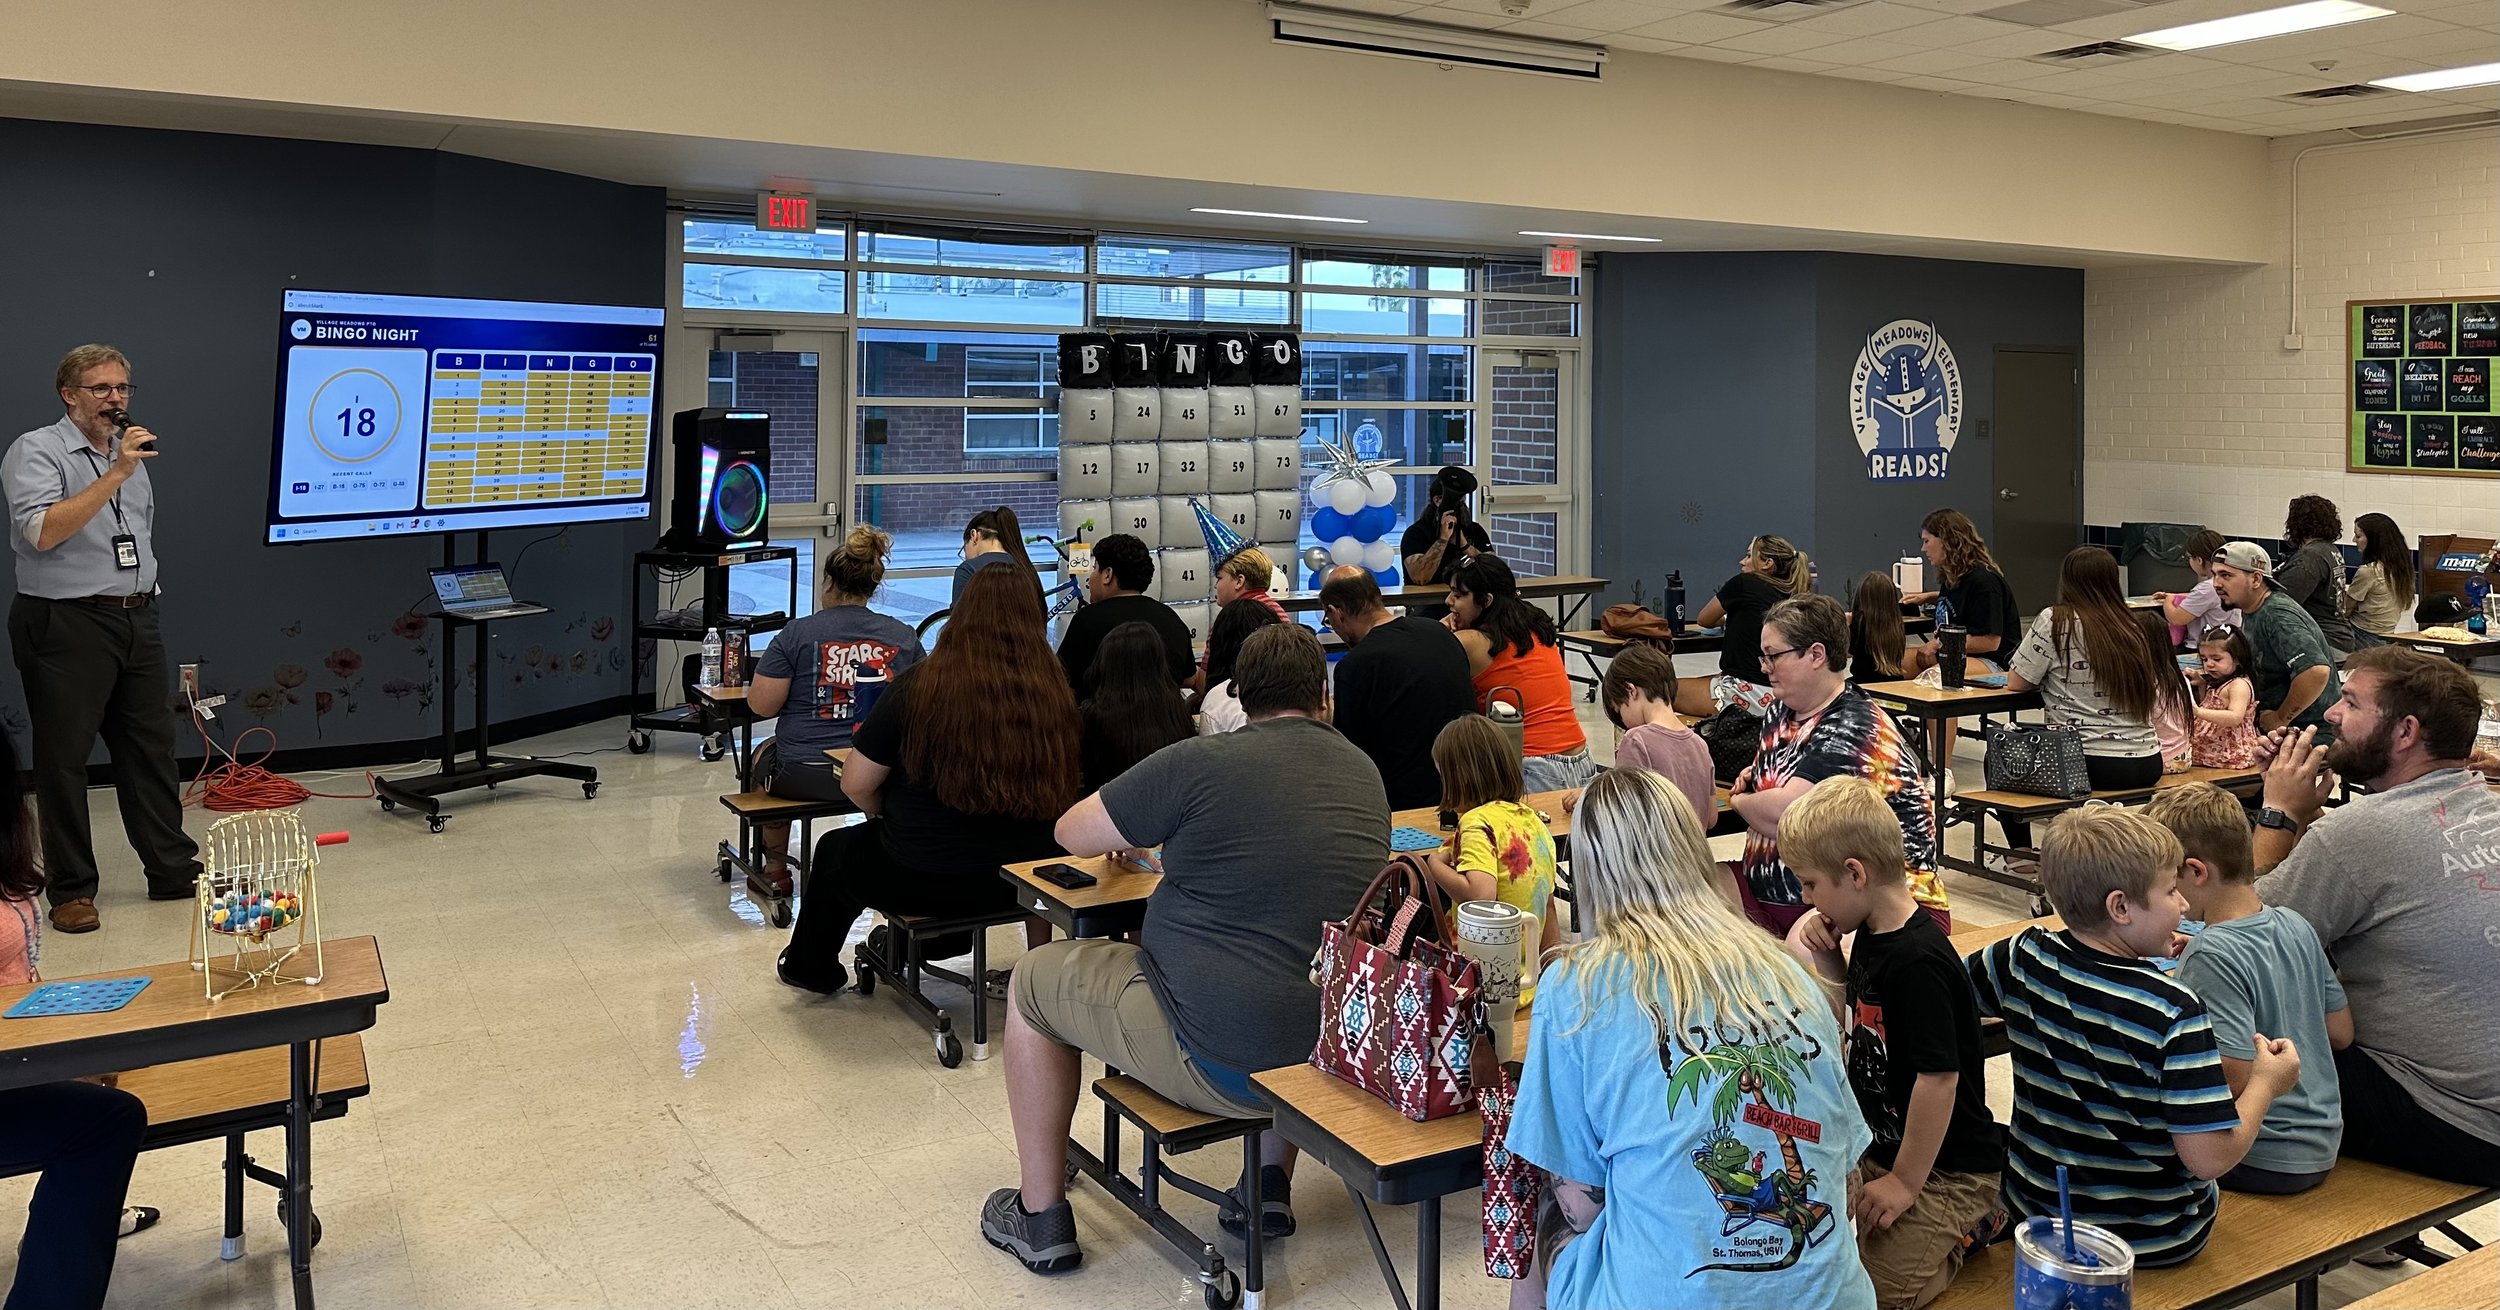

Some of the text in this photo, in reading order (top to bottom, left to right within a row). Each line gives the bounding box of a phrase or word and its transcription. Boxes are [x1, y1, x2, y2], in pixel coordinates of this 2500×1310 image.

[769, 197, 808, 228] EXIT
[1552, 249, 1576, 273] EXIT
[316, 327, 418, 341] BINGO NIGHT
[1874, 326, 1929, 352] MEADOWS
[2414, 340, 2446, 350] FEEDBACK
[547, 359, 553, 367] N
[2364, 367, 2386, 381] Great
[2453, 375, 2481, 383] REACH
[355, 395, 358, 403] I
[1854, 360, 1870, 434] VILLAGE
[1938, 348, 1958, 434] ELEMENTARY
[1090, 404, 1288, 420] 5 24 45 51 67
[338, 408, 375, 436] 18
[2416, 449, 2449, 458] Strategies
[1082, 457, 1291, 475] 12 17 32 59 73
[1872, 452, 1948, 478] READS!
[1134, 509, 1292, 529] 30 48 70
[1182, 570, 1194, 581] 41
[827, 643, 883, 666] STARS
[818, 687, 826, 698] &
[1746, 1106, 1773, 1129] BEACH
[1774, 1115, 1791, 1132] BAR
[1797, 1123, 1819, 1140] GRILL
[1734, 1236, 1783, 1247] Bolongo Bay
[1713, 1247, 1783, 1258] St. Thomas, USVI
